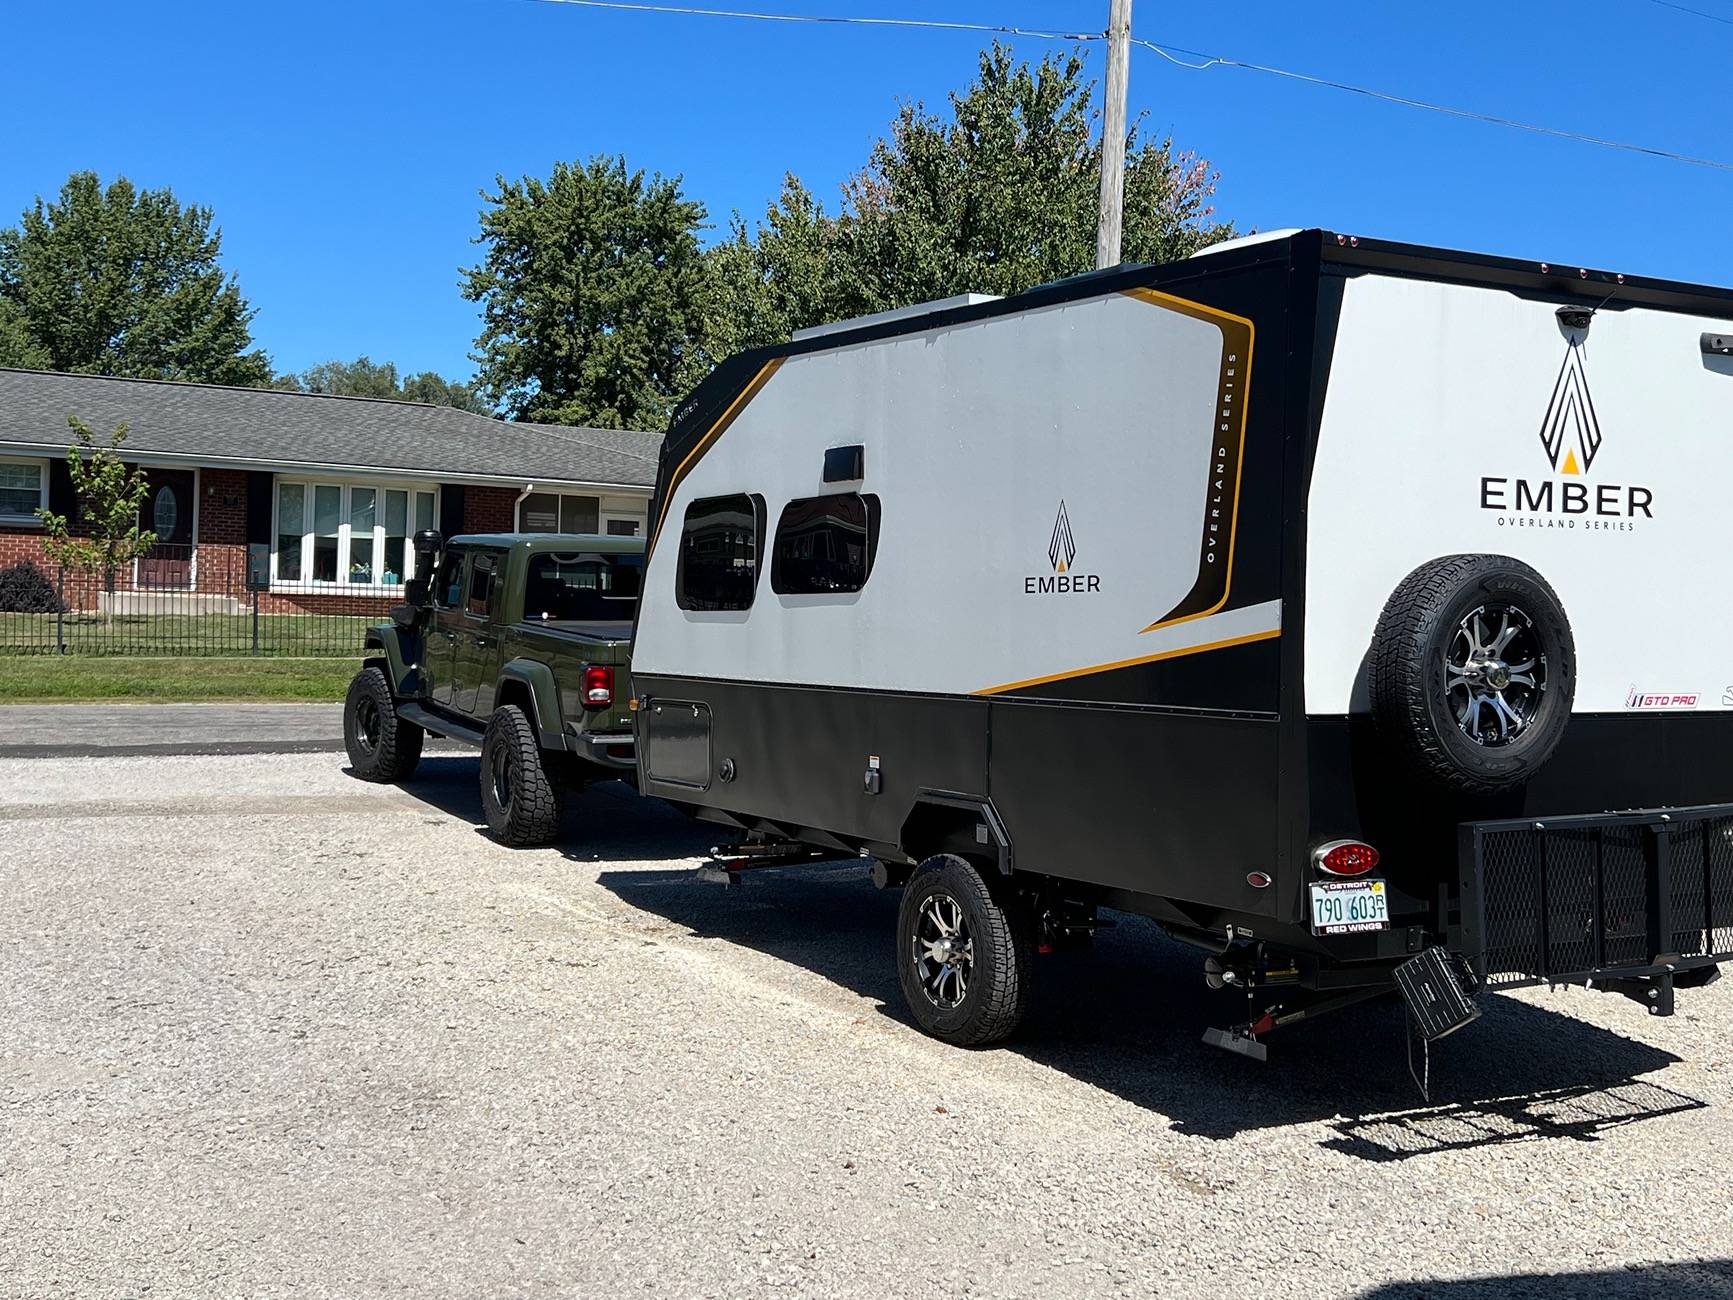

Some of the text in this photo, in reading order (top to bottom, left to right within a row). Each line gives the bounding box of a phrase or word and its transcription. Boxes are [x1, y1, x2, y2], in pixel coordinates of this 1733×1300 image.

[1207, 354, 1236, 563] OVERLAND SERIES
[1480, 476, 1653, 518] EMBER
[1497, 517, 1634, 531] OVERLAND SERIES
[1025, 575, 1100, 593] EMBER
[1671, 696, 1697, 706] PRO
[1329, 881, 1368, 890] DETROIT
[1315, 897, 1343, 923] 790
[1350, 895, 1377, 920] 603
[1325, 922, 1383, 934] RED WINGS
